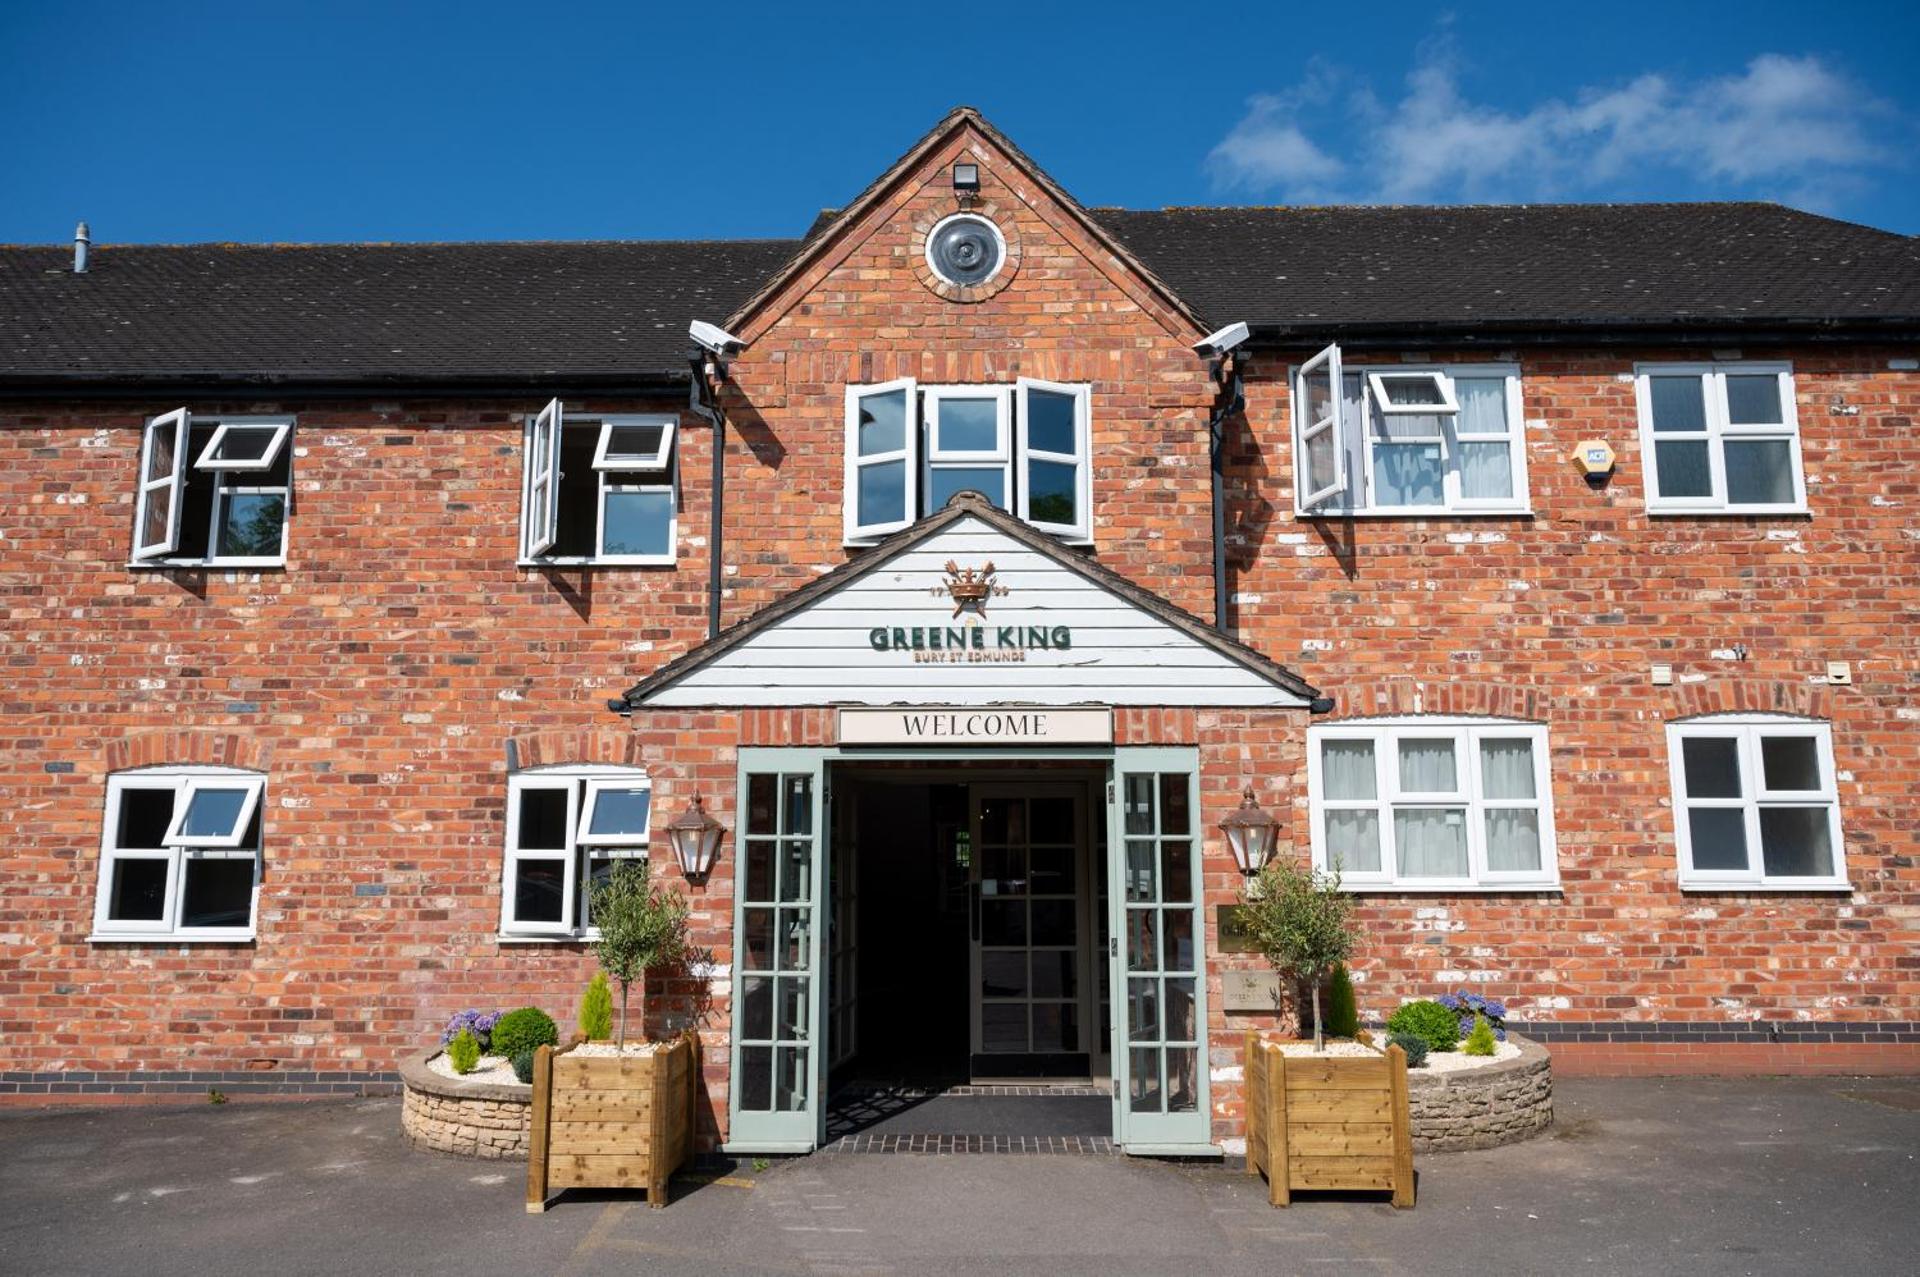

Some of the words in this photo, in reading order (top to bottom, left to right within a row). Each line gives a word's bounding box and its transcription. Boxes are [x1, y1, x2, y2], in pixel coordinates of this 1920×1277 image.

[870, 626, 984, 651] GREENE
[998, 626, 1071, 651] KING
[914, 652, 946, 663] BURY
[950, 652, 963, 663] ST
[967, 652, 1026, 663] EDMUNDS
[903, 714, 1047, 736] WELCOME
